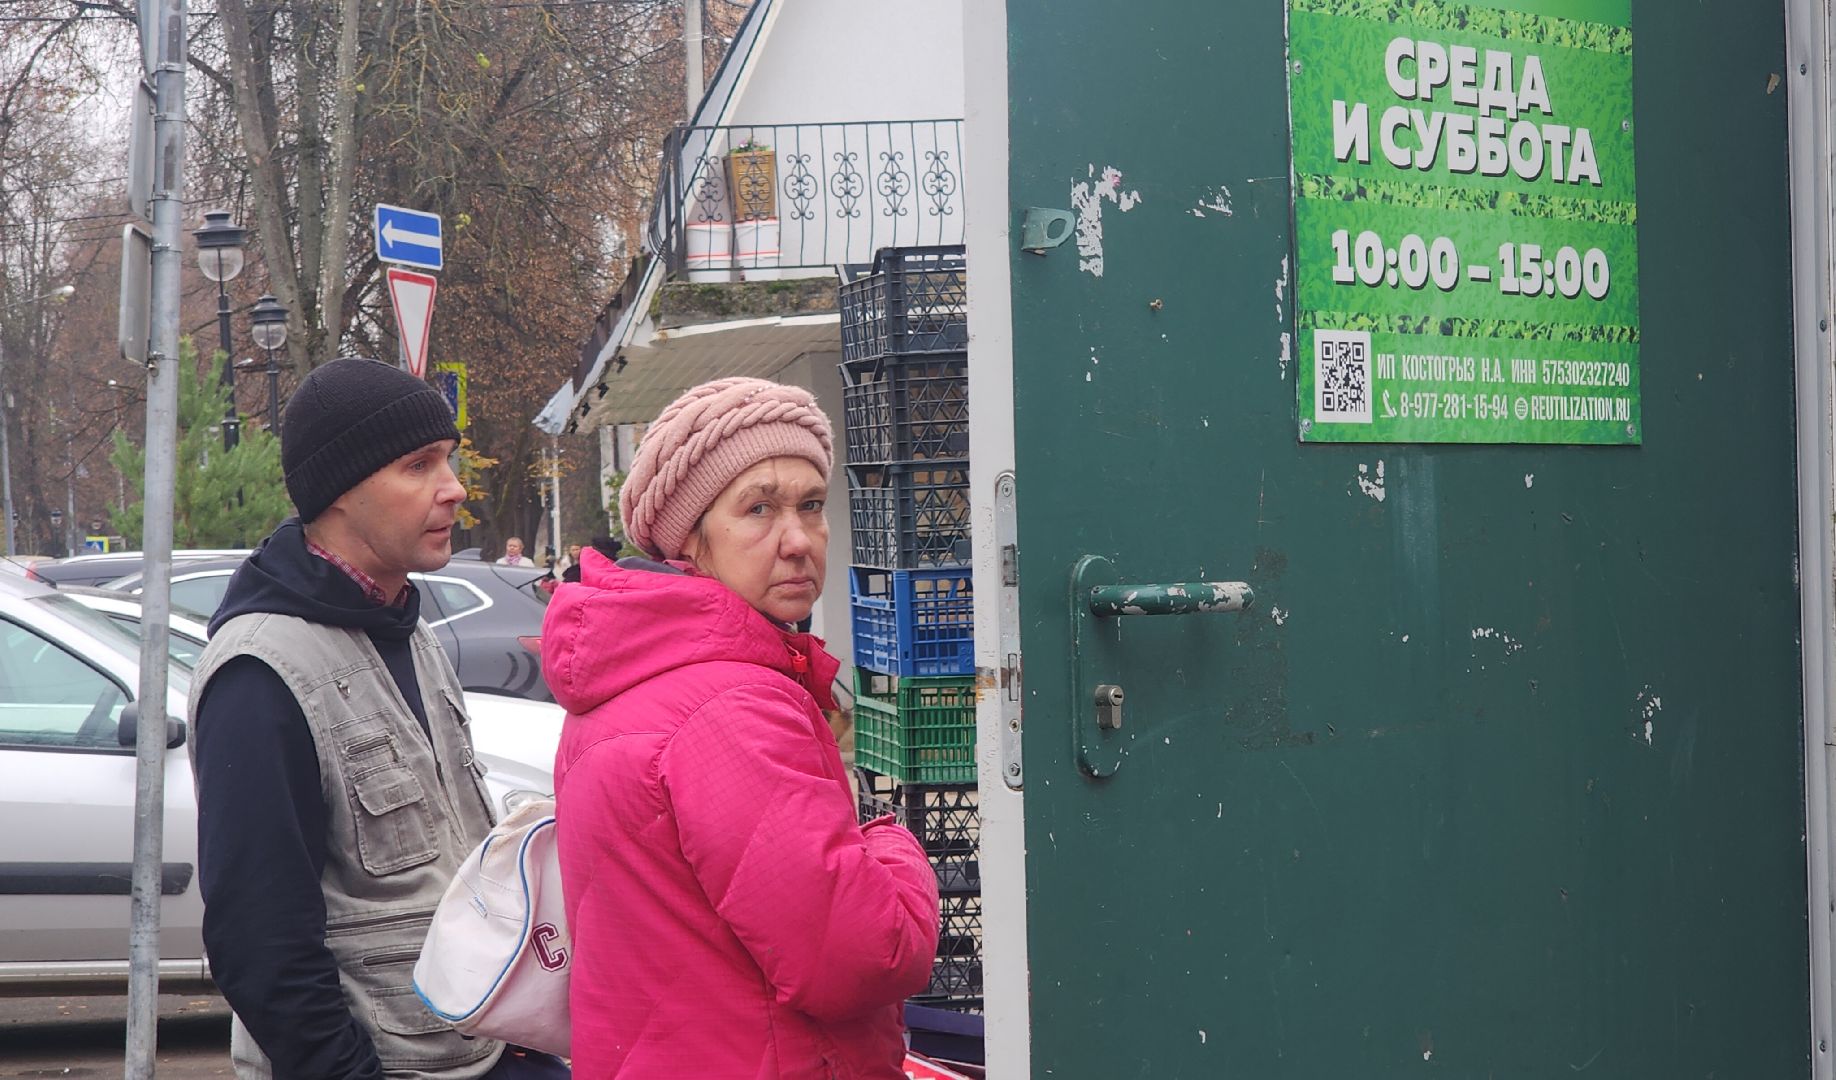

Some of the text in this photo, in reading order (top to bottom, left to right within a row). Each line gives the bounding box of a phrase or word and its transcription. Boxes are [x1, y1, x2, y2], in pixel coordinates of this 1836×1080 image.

[1385, 37, 1553, 121] СРЕДА
[1332, 100, 1602, 187] И СУББОТА
[1332, 229, 1459, 292] 10:00
[1499, 242, 1610, 301] 15:00
[1377, 353, 1630, 387] ИП КОСТОГРЫЗ Н.А. ИНН 575302327240
[1400, 392, 1630, 421] 8-977-281-15-94 REUTILIZATION.RU
